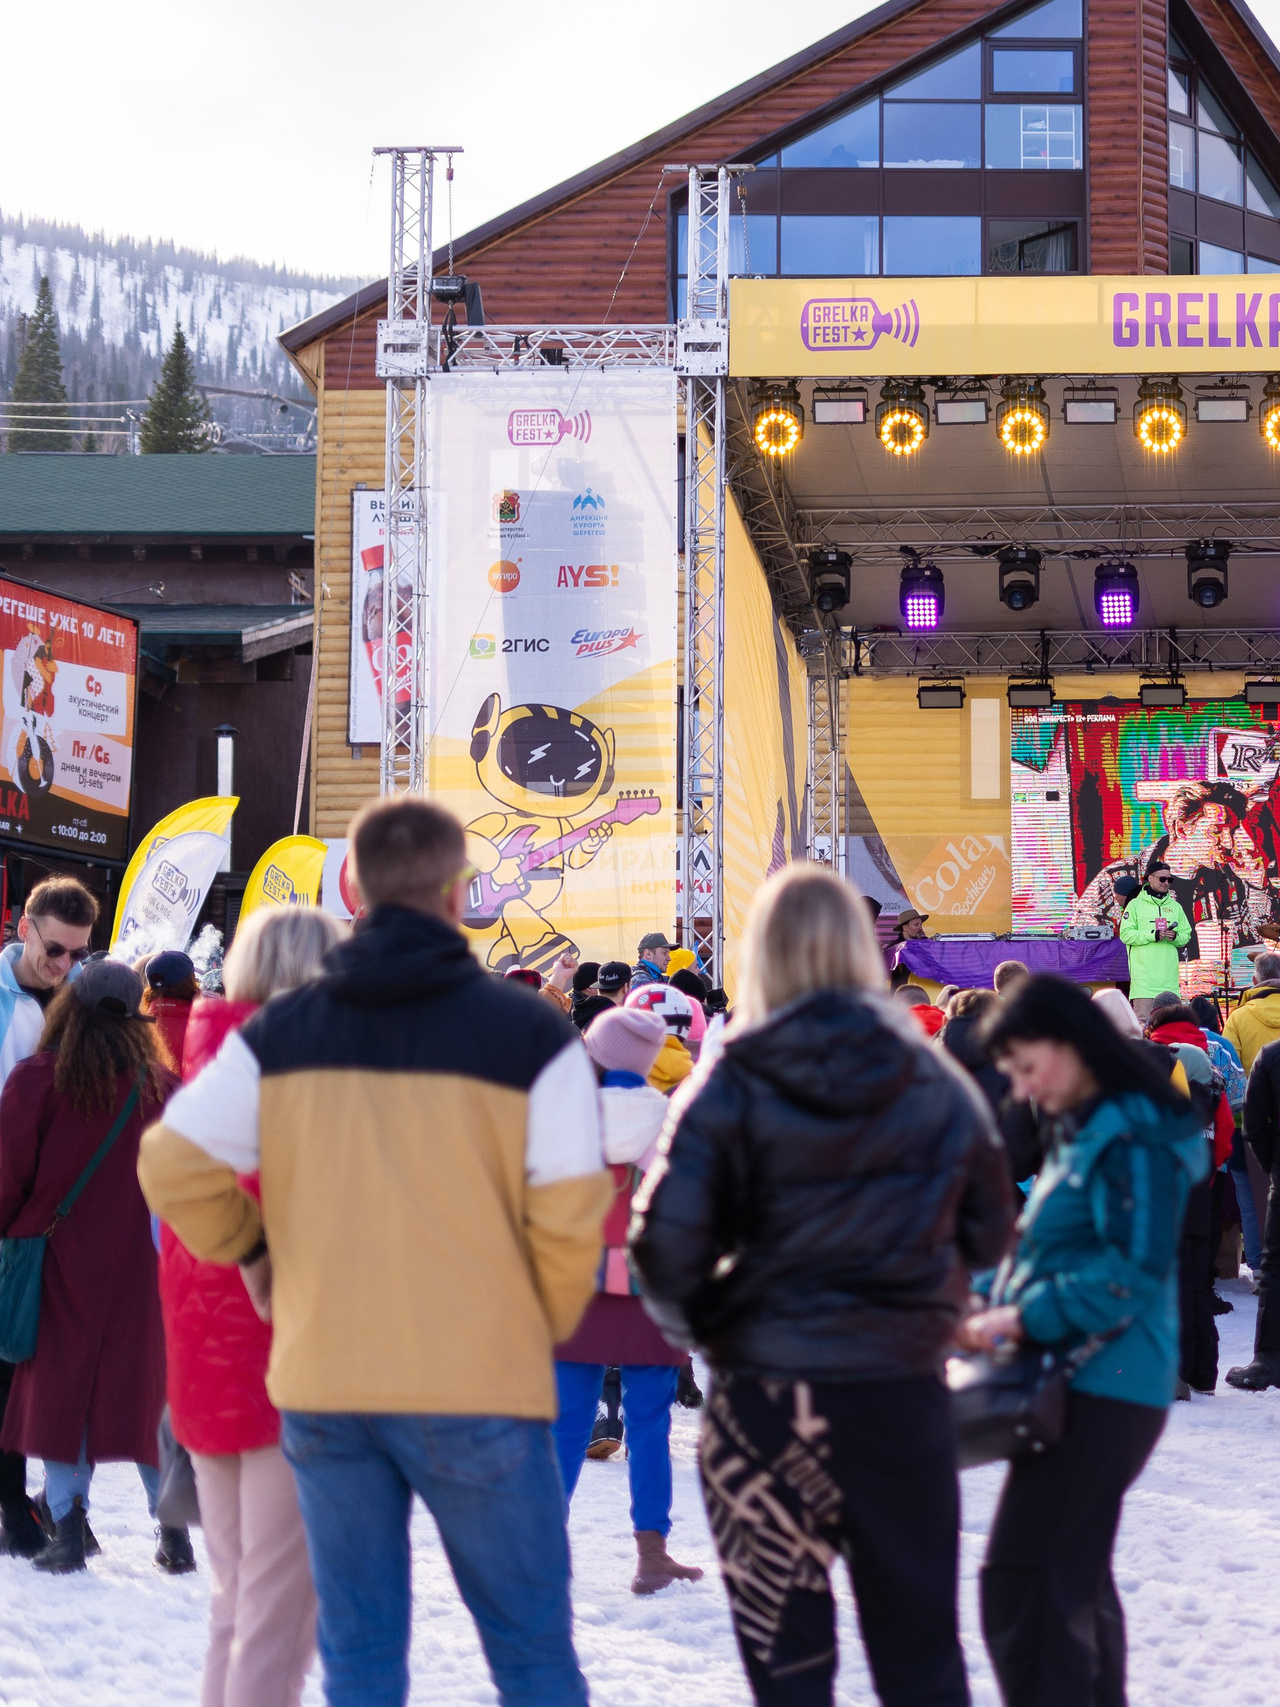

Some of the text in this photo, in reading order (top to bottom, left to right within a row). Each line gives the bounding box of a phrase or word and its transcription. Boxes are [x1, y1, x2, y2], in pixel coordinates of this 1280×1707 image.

[813, 305, 868, 323] GRELKA
[813, 326, 850, 343] FEST
[516, 414, 556, 427] GRELKA
[516, 428, 543, 441] FEST
[557, 564, 619, 588] AYS!
[49, 611, 79, 634] УЖЕ
[82, 622, 95, 639] 10
[97, 627, 126, 648] ЛЕТ!
[571, 628, 630, 645] Europa
[502, 639, 550, 653] 2ГИС
[68, 694, 119, 715] акустический
[78, 707, 109, 723] концерт
[1087, 714, 1116, 723] РЕКЛАМА
[61, 762, 81, 774] днем
[89, 768, 121, 783] вечером
[58, 824, 78, 838] 10:00
[79, 831, 89, 841] до
[90, 831, 107, 844] 2:00
[155, 876, 174, 894] FEST
[161, 865, 186, 888] GRELKA
[269, 869, 291, 892] GRELKA
